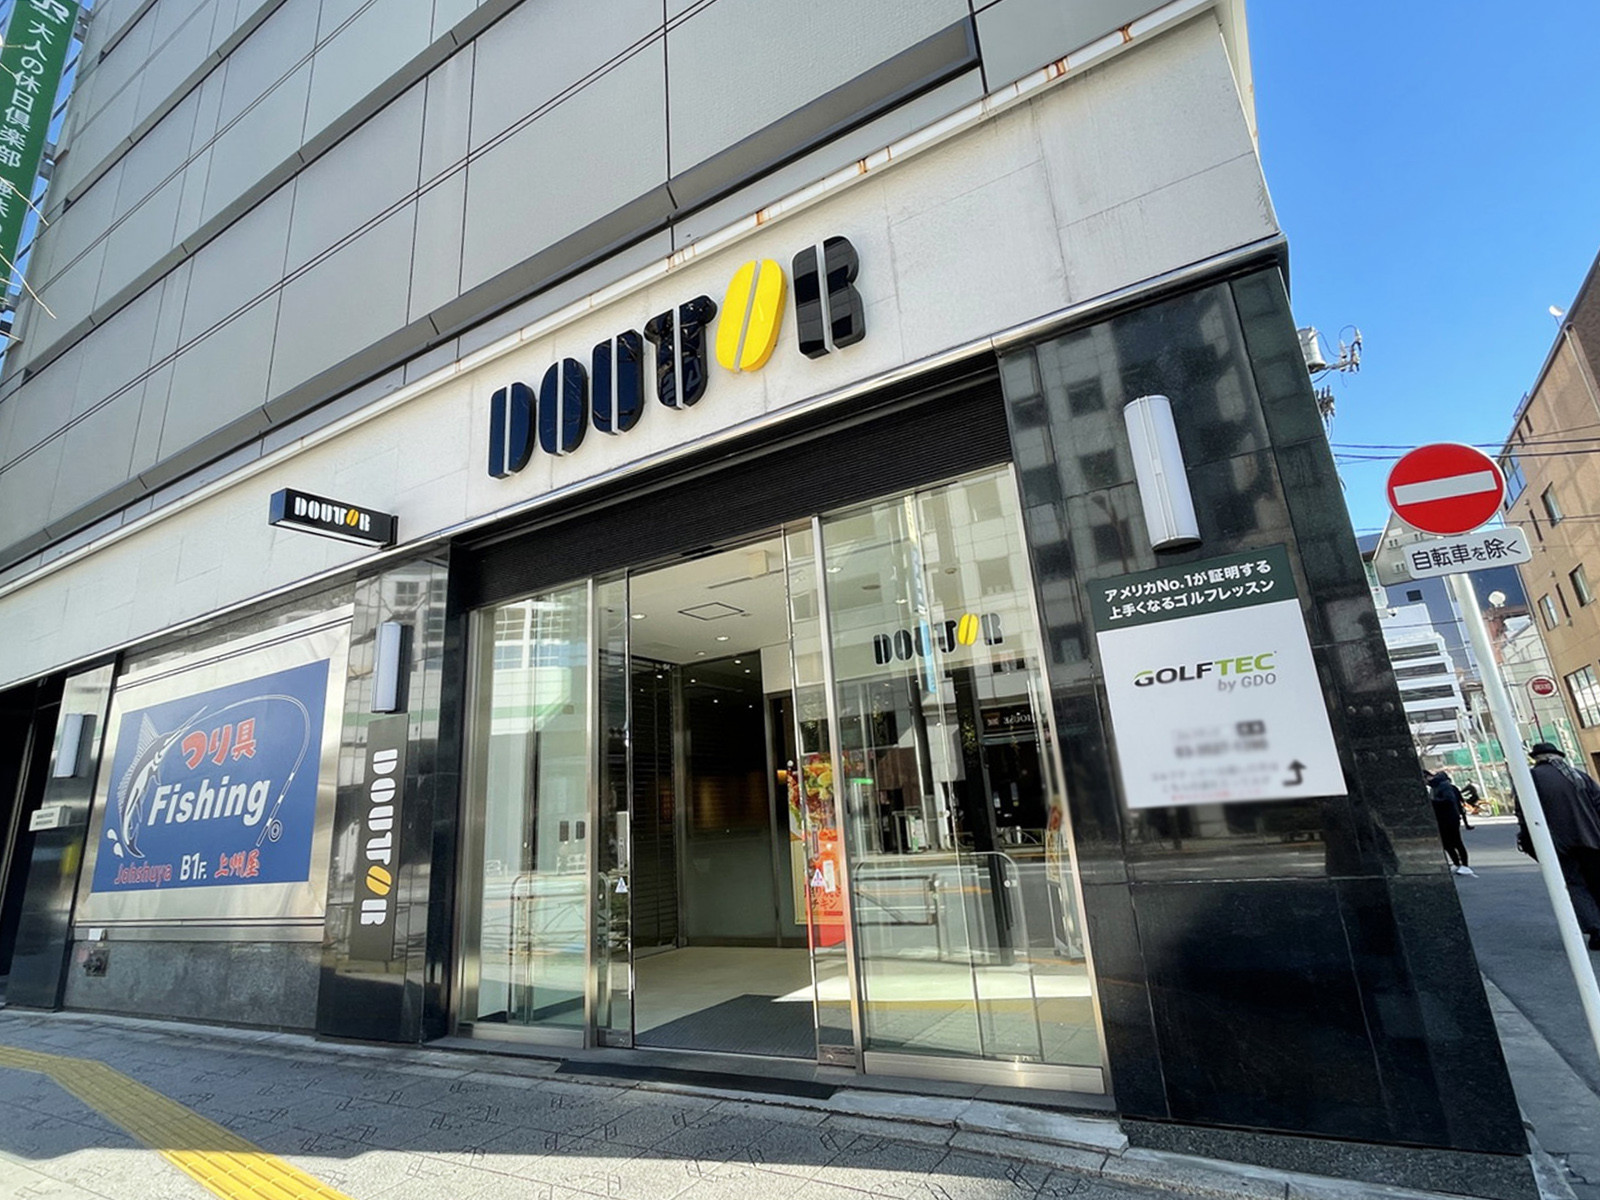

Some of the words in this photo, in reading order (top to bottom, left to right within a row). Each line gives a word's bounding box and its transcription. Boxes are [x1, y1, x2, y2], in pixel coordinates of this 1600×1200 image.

[487, 235, 867, 480] DOUTOR
[294, 496, 370, 532] DOUTOR
[1412, 538, 1522, 571] 自転車を除く
[1104, 559, 1272, 603] アメリカNo.1が証明する
[1108, 579, 1275, 620] 上手くなるゴルフレッスン
[1133, 652, 1276, 687] GOLFTEC
[1218, 679, 1236, 692] by
[1241, 673, 1276, 687] GDO
[181, 717, 256, 770] つり具
[147, 775, 271, 826] Fishing
[360, 749, 398, 925] DOUTOR
[214, 848, 261, 878] 上州屋
